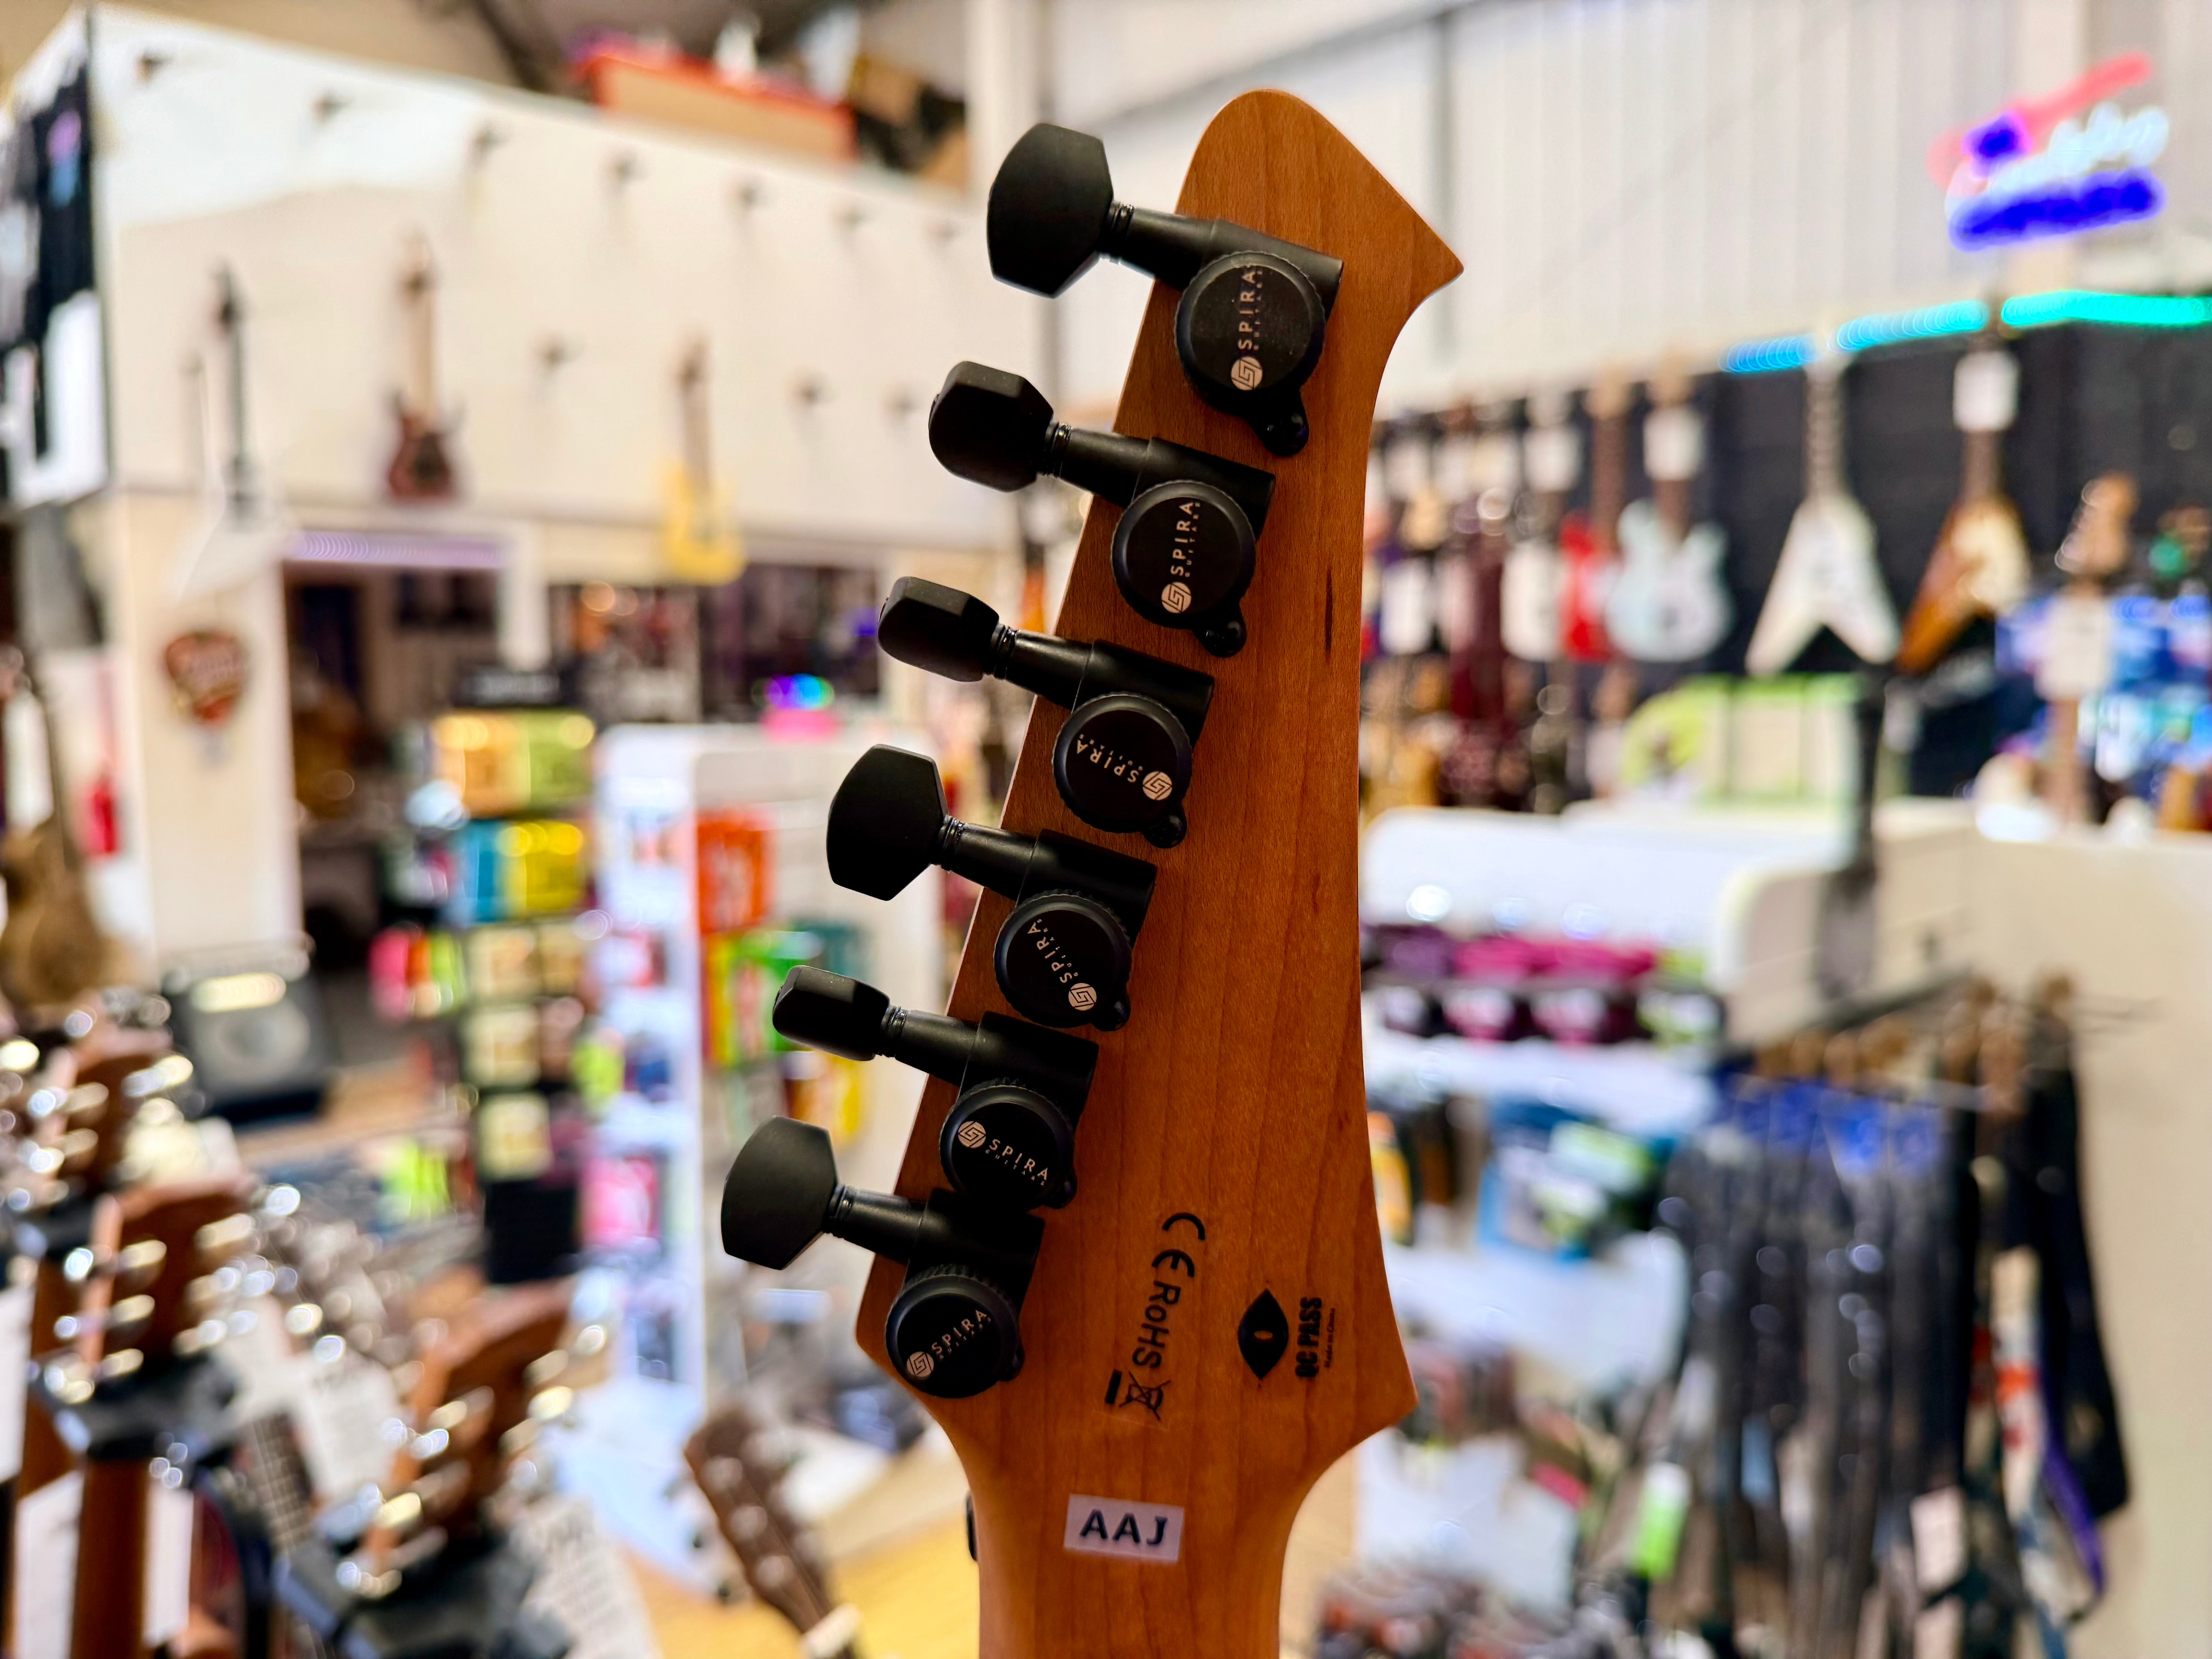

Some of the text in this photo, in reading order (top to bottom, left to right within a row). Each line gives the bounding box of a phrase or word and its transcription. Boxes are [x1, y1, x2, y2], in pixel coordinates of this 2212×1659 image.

[1238, 271, 1256, 350] SPIRA
[1170, 502, 1193, 576] SPIRA
[1077, 739, 1139, 783] SPIRA
[1027, 922, 1072, 983] SPIRA
[989, 1139, 1048, 1181] SPIRA
[932, 1309, 988, 1355] SPIRA
[1295, 1297, 1322, 1377] QC PASS
[1079, 1509, 1168, 1546] AAJ
